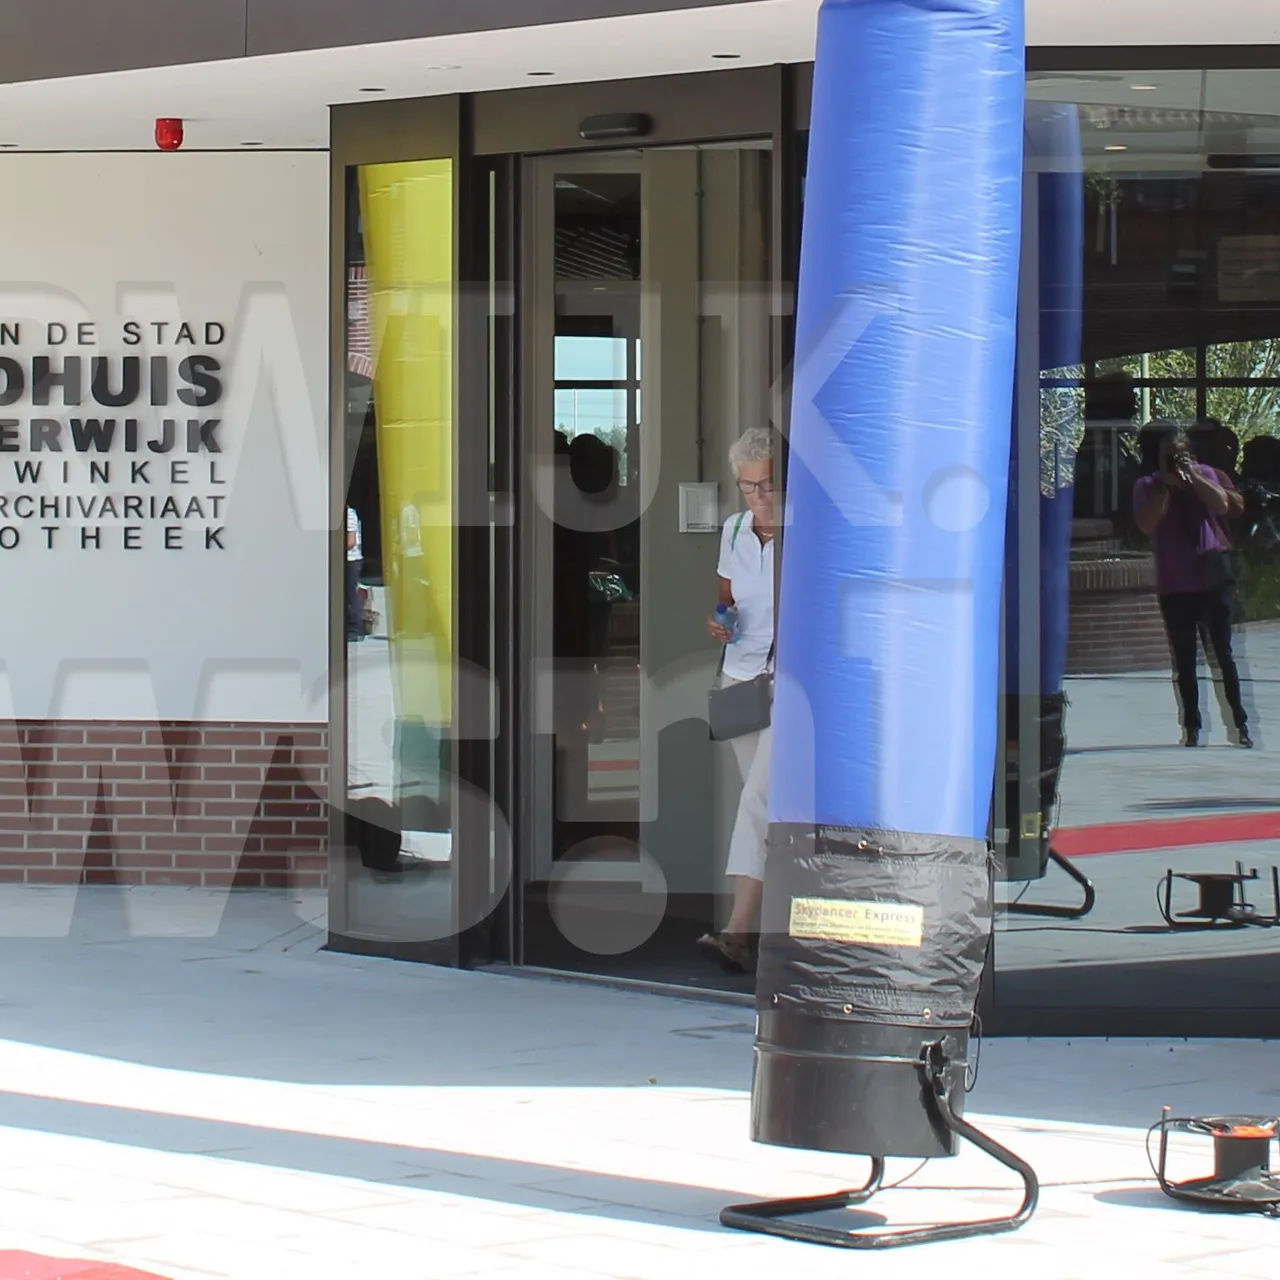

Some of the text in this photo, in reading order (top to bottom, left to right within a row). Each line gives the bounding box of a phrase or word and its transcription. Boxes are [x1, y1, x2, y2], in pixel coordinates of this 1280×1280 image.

[48, 323, 95, 345] DE
[123, 322, 225, 345] STAD
[795, 902, 916, 923] Skydancer Express
